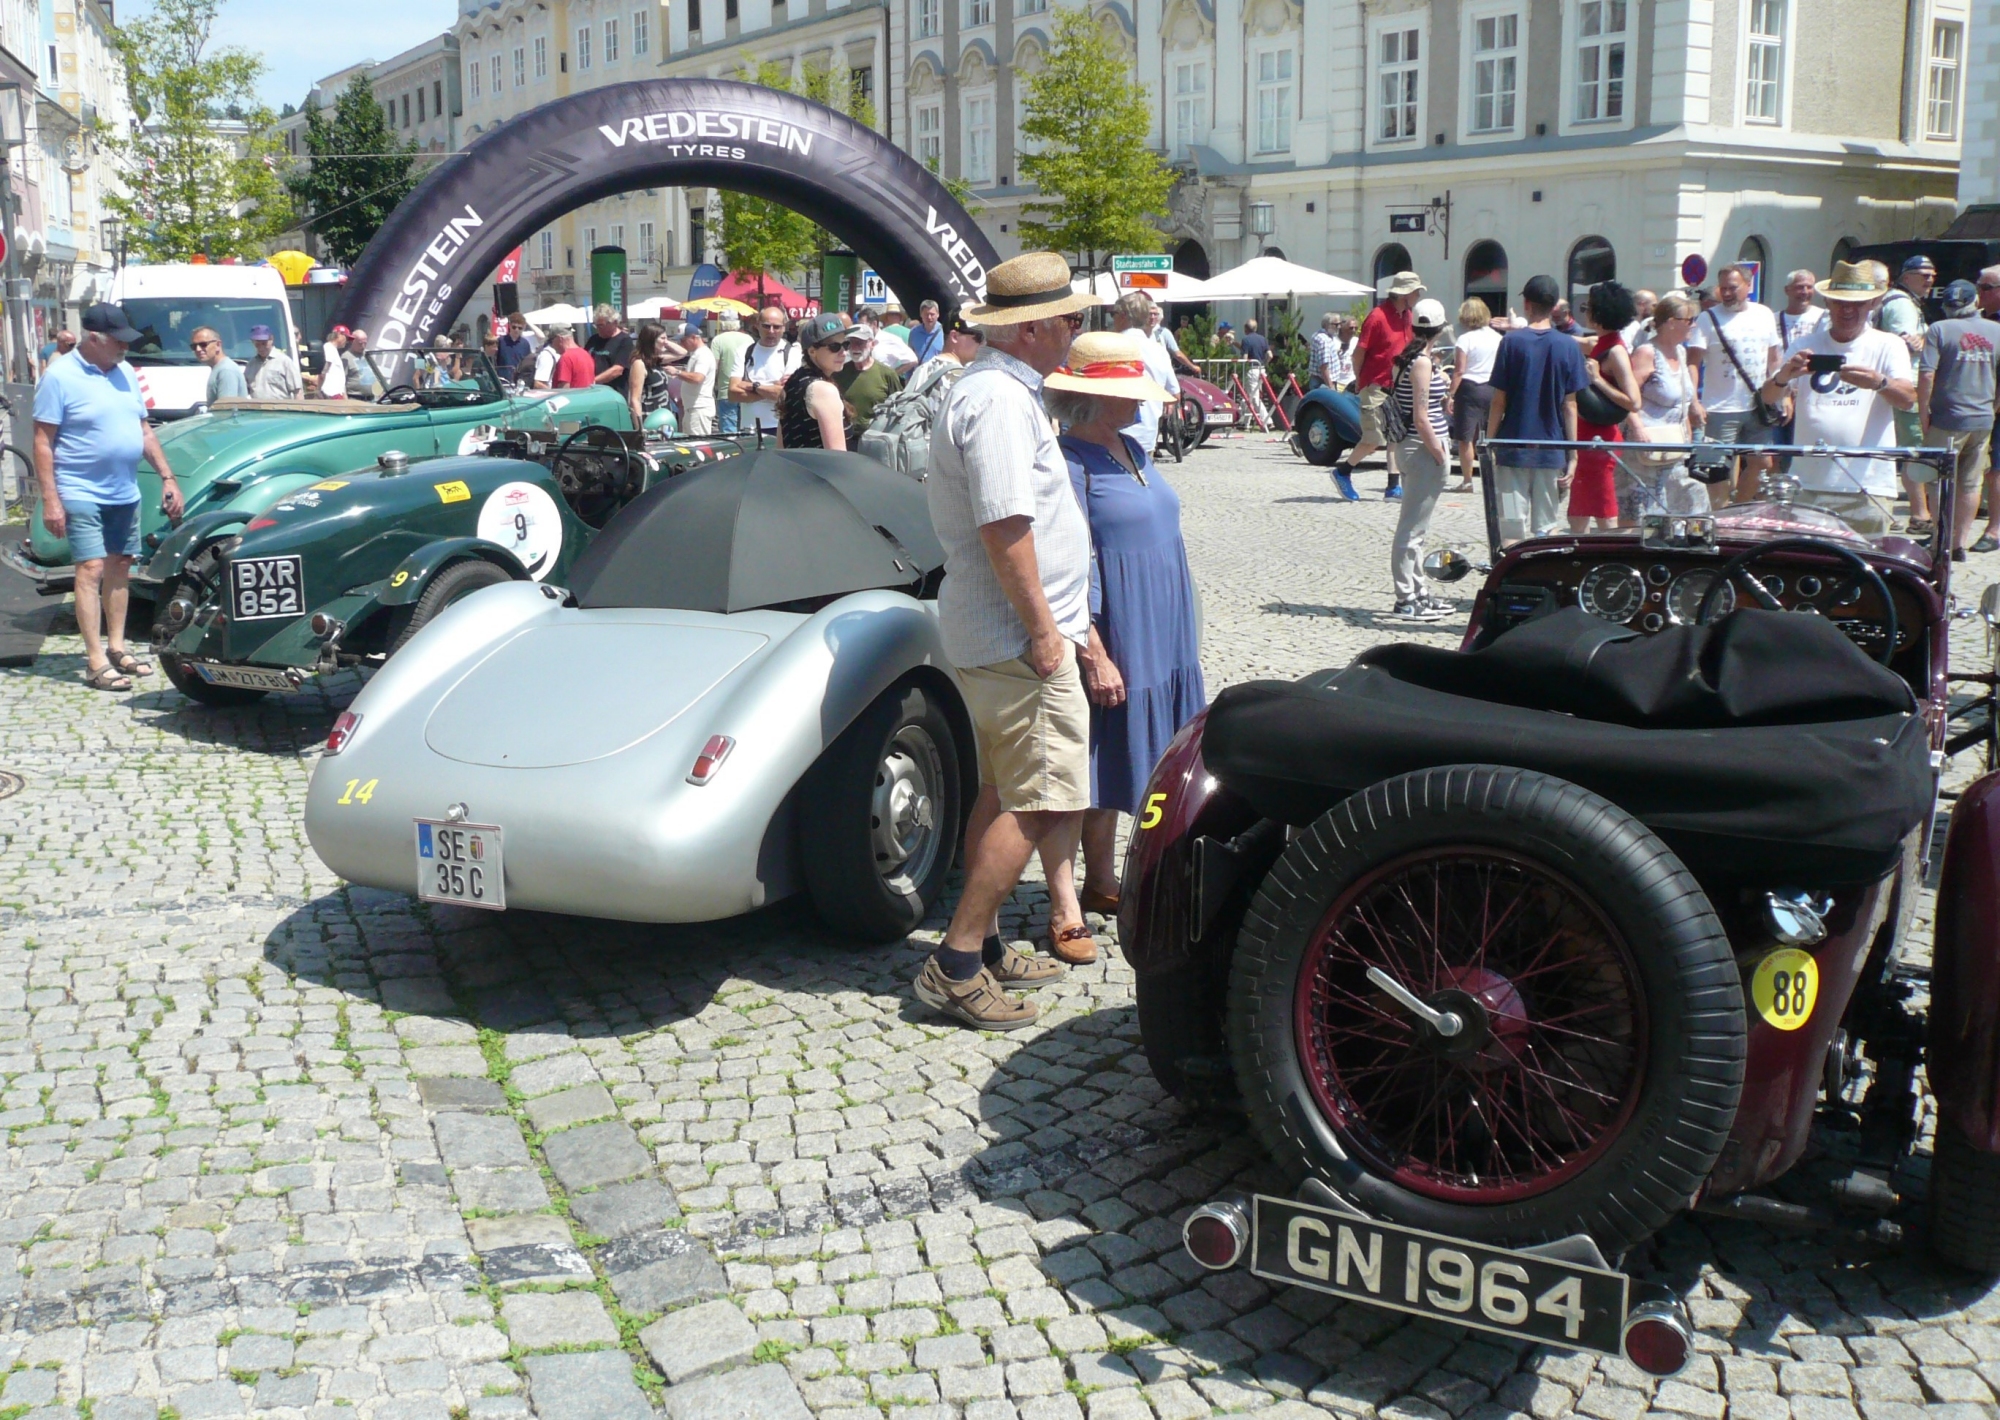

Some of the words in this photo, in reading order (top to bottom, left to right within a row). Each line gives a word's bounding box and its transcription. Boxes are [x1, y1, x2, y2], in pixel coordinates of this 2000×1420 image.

[598, 111, 813, 156] VREDESTEIN
[667, 144, 746, 160] TYRES
[1115, 259, 1157, 269] Stadtausfahrt
[371, 204, 484, 387] EDESTEIN
[948, 271, 969, 297] TY
[514, 513, 528, 541] 9
[237, 560, 296, 589] BXR
[391, 571, 409, 587] 9
[239, 587, 298, 616] 852
[235, 672, 267, 687] 273
[337, 778, 379, 805] 14
[1140, 793, 1168, 830] 5
[423, 845, 430, 855] A
[437, 829, 467, 863] SE
[436, 863, 465, 897] 35
[469, 867, 484, 899] C
[1773, 970, 1807, 1017] 88
[1287, 1215, 1384, 1295] GN
[1404, 1240, 1586, 1340] 1964
